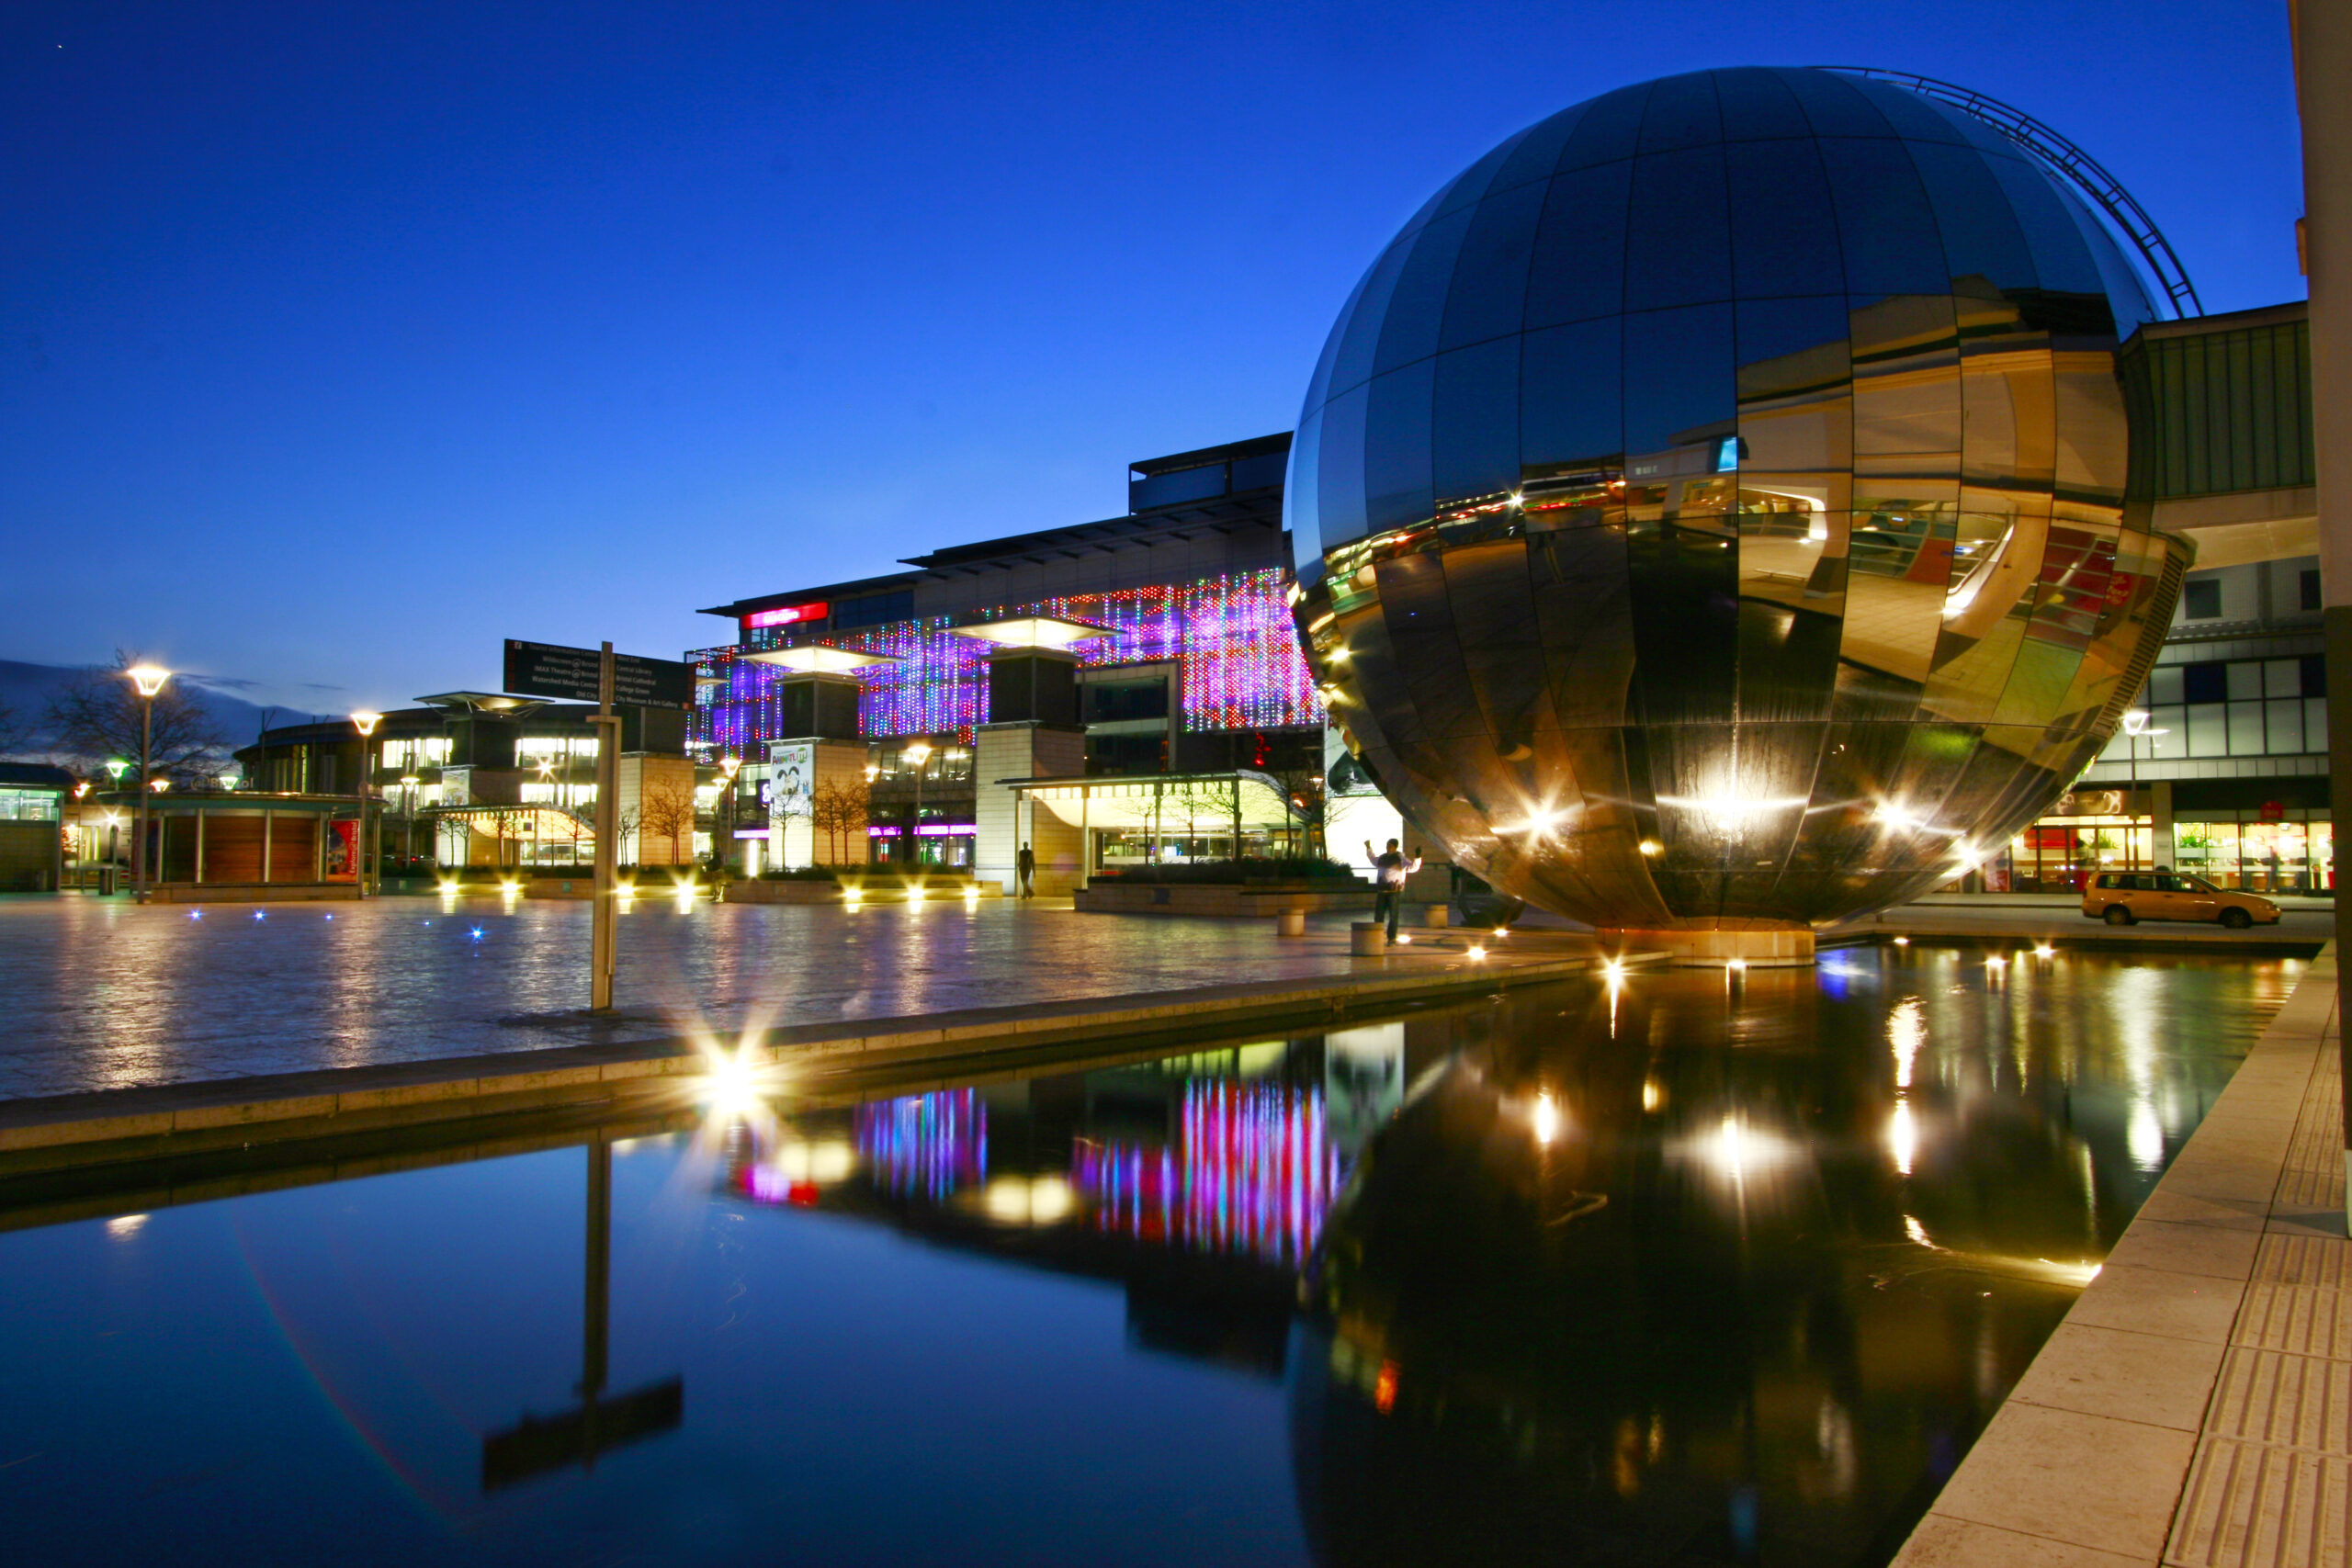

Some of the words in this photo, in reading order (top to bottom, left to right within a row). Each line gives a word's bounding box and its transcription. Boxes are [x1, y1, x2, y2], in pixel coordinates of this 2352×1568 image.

[635, 667, 652, 676] Library
[532, 676, 560, 684] Watershed
[562, 679, 580, 687] Media
[580, 681, 598, 689] Centre
[616, 684, 634, 694] College
[576, 690, 585, 698] Old
[586, 692, 597, 701] City
[616, 694, 626, 704] City
[662, 700, 678, 709] Gallery
